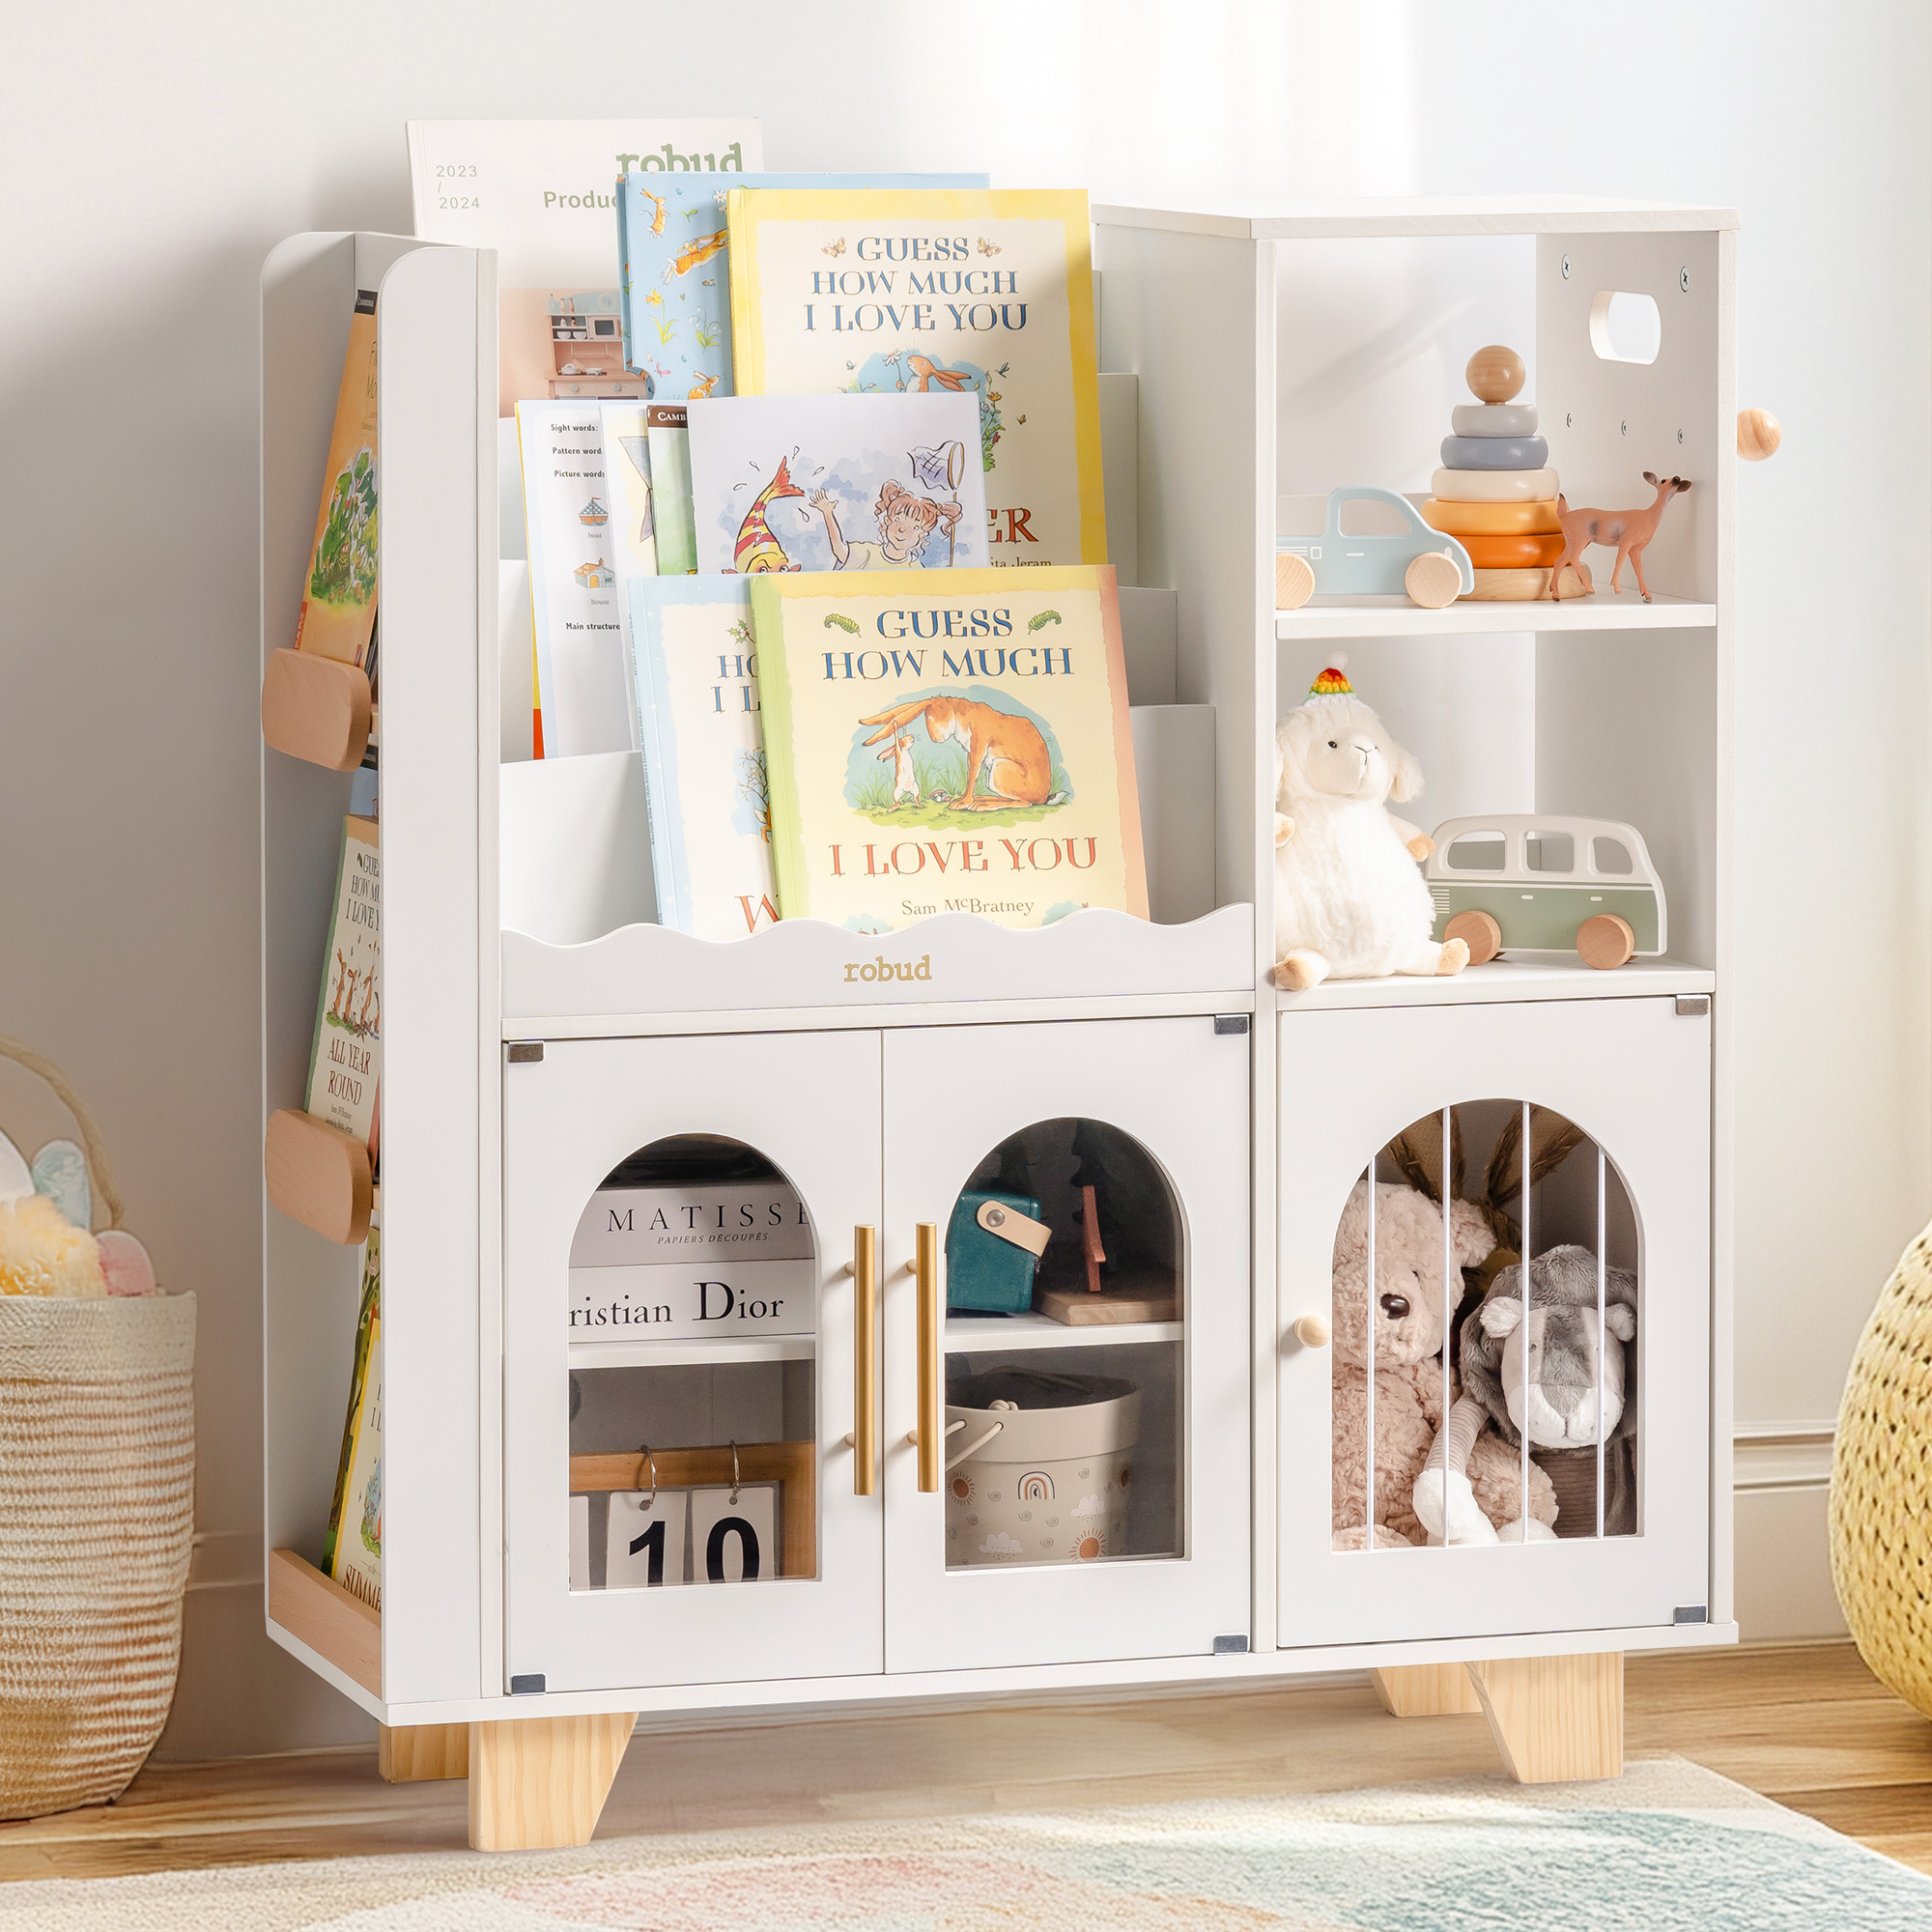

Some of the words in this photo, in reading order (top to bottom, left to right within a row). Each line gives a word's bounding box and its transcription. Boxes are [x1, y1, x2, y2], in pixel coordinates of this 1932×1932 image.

[436, 165, 477, 178] 2023
[615, 142, 743, 177] robud
[440, 196, 480, 210] 2024
[857, 237, 970, 262] GUESS
[810, 270, 897, 296] HOW
[908, 270, 1019, 296] MUCH
[804, 303, 816, 332] I
[831, 303, 935, 332] LOVE
[944, 302, 1029, 332] YOU
[551, 423, 570, 433] Sight
[572, 423, 598, 432] words:
[657, 412, 687, 421] CAMB
[876, 608, 1014, 640] GUESS
[821, 648, 927, 682] HOW
[941, 647, 1075, 678] MUCH
[711, 685, 725, 714] I
[363, 854, 379, 877] GUE
[827, 844, 846, 877] I
[863, 839, 989, 877] LOVE
[998, 837, 1097, 871] YOU
[351, 874, 370, 897] HOW
[352, 900, 375, 929] LOVE
[901, 899, 937, 916] Sam
[944, 897, 1035, 917] McBratney
[843, 954, 933, 983] robud
[327, 1037, 346, 1065] ALL
[348, 1043, 371, 1075] YEAR
[327, 1070, 362, 1105] ROUND
[607, 1202, 810, 1233] MATISSE
[657, 1235, 705, 1245] PAPIERS
[708, 1232, 769, 1243] DÉCOUPÉS
[568, 1294, 674, 1327] ristian
[692, 1281, 784, 1321] Dior
